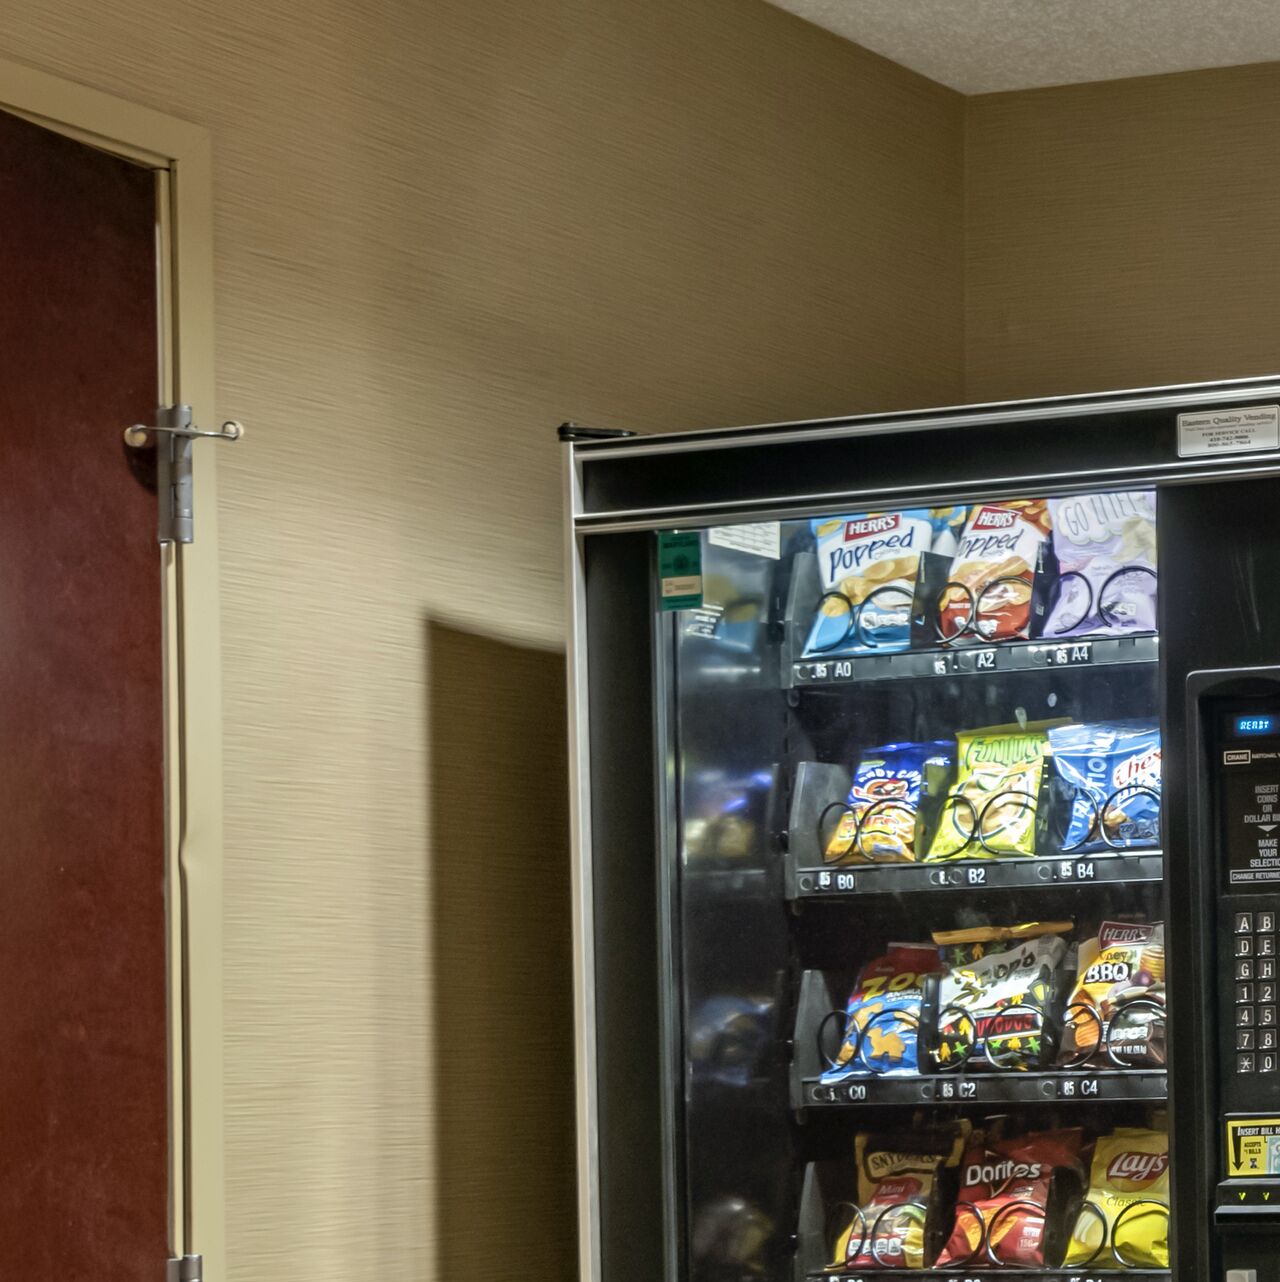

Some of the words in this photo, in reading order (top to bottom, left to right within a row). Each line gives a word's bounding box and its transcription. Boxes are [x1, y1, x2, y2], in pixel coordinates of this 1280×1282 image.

[1213, 416, 1242, 425] Quality
[1243, 413, 1276, 421] Vending
[848, 514, 900, 535] HERR'S
[978, 510, 1014, 528] HERR'S
[1064, 502, 1090, 536] GO
[829, 526, 914, 581] Popped
[977, 652, 996, 668] A2
[1072, 645, 1089, 660] A4
[834, 662, 852, 677] A0
[1240, 720, 1270, 730] READY
[1255, 784, 1279, 794] INSERT
[1257, 794, 1278, 803] COINS
[1262, 804, 1273, 813] OR
[1244, 814, 1271, 823] DOLLAR
[1258, 839, 1278, 848] MAKE
[1259, 848, 1278, 857] YOUR
[969, 868, 985, 883] B2
[1078, 863, 1094, 878] B4
[1232, 872, 1255, 880] CHANGE
[838, 873, 854, 890] B0
[1103, 928, 1146, 941] HERR'S
[1087, 963, 1129, 982] BBQ
[849, 1086, 866, 1100] C0
[959, 1083, 975, 1098] C2
[1081, 1080, 1098, 1095] C4
[1237, 1126, 1260, 1137] INSERT
[1261, 1126, 1274, 1135] BILL
[1109, 1152, 1168, 1179] Lay's
[966, 1161, 1041, 1186] Doritos
